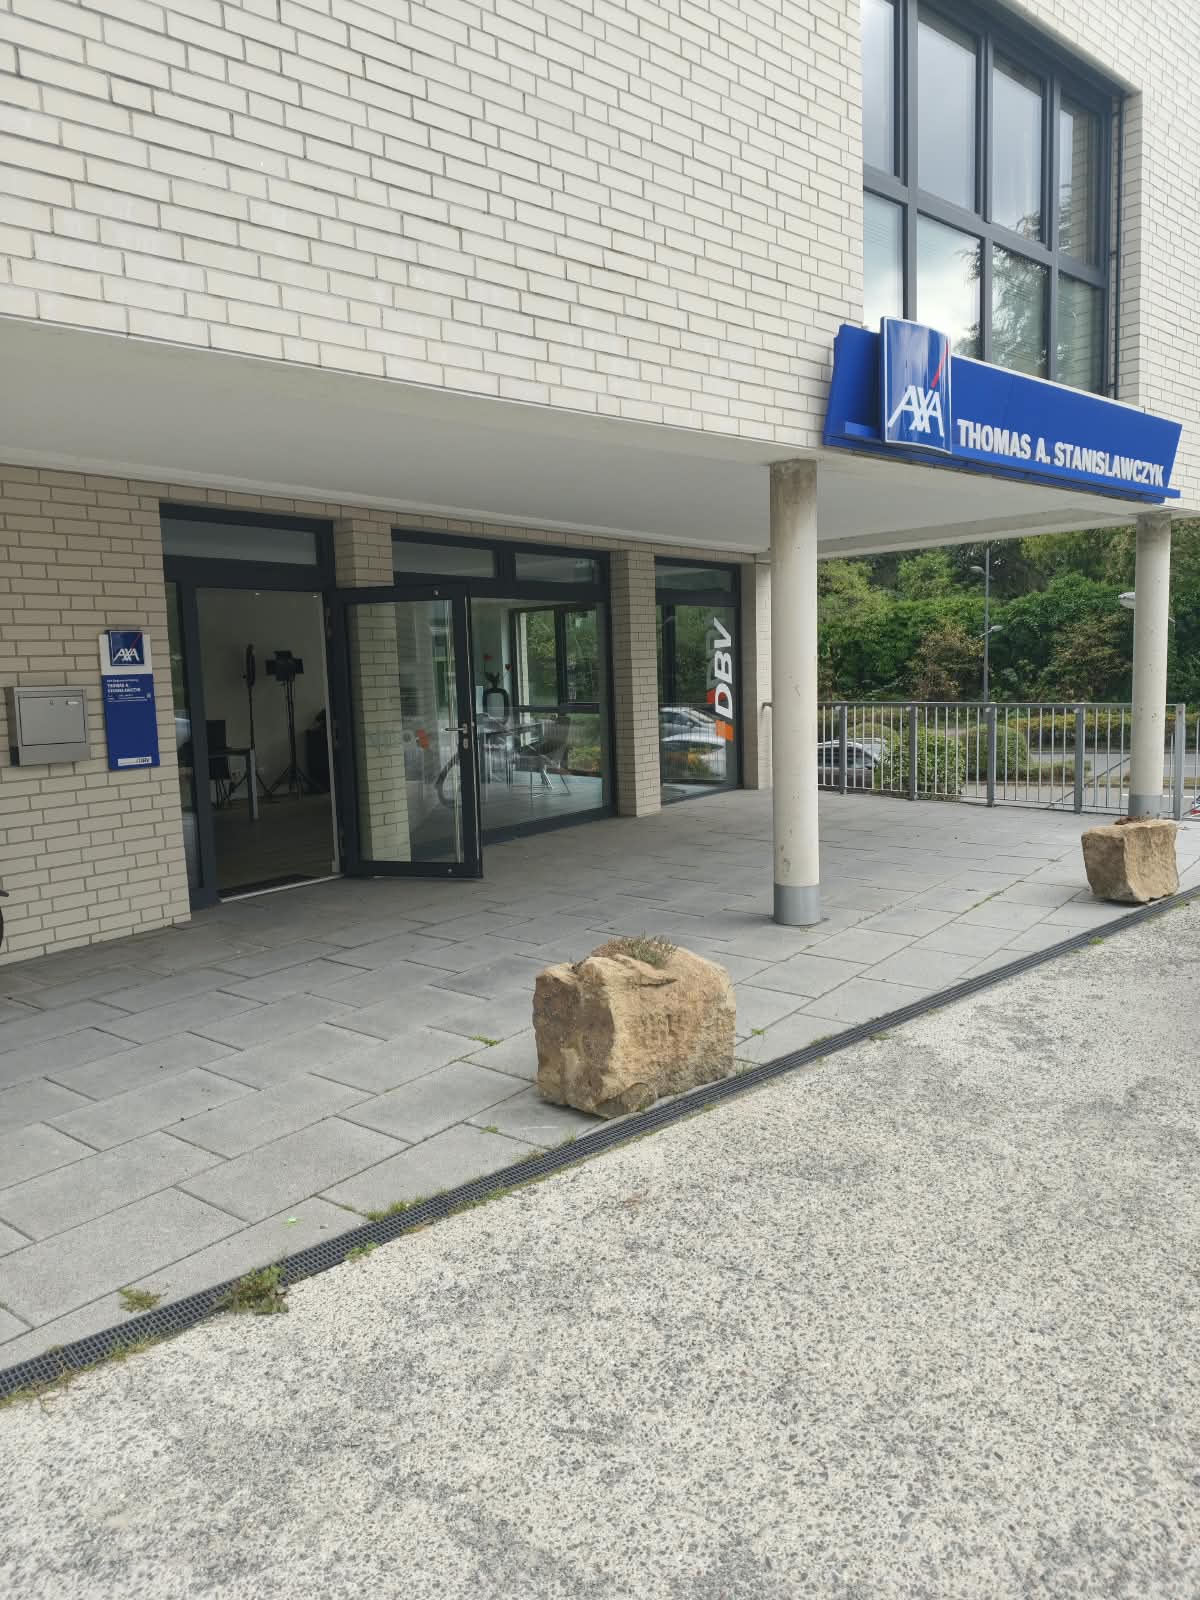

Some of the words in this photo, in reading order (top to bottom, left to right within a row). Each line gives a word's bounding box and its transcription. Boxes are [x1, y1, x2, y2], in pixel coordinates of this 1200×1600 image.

[888, 385, 945, 437] AXA
[957, 418, 1031, 459] THOMAS
[1035, 437, 1050, 464] A.
[1054, 441, 1164, 487] STANISLAWCZYK
[112, 648, 139, 662] AXA
[713, 616, 733, 720] DBV
